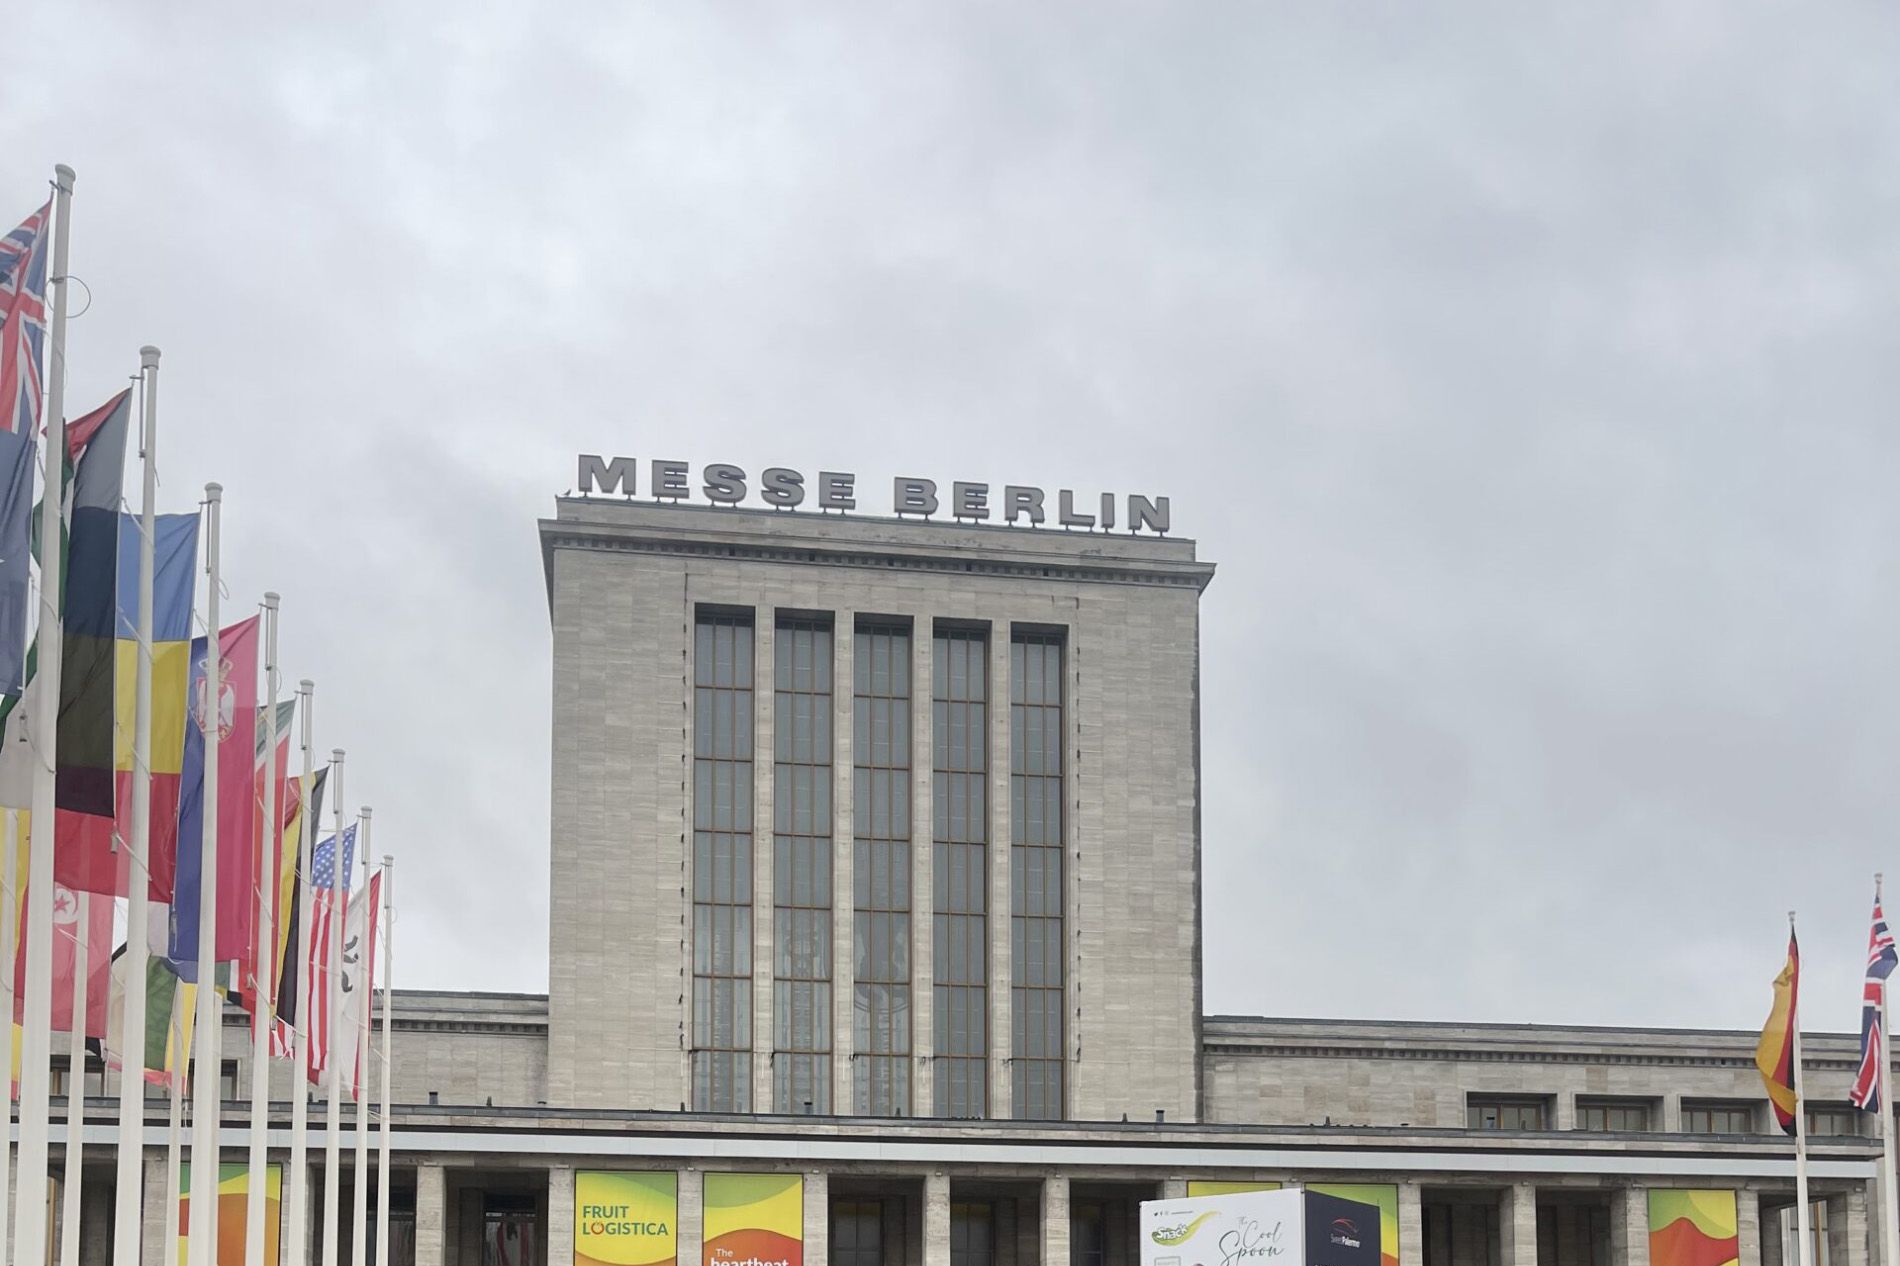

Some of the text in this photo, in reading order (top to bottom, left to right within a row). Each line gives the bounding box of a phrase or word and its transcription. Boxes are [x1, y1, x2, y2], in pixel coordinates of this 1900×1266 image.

[578, 454, 1171, 533] MESSE BERLIN
[583, 1205, 629, 1218] FRUIT
[583, 1221, 669, 1236] LOGISTICA
[1243, 1220, 1281, 1248] Cool
[716, 1248, 733, 1257] The
